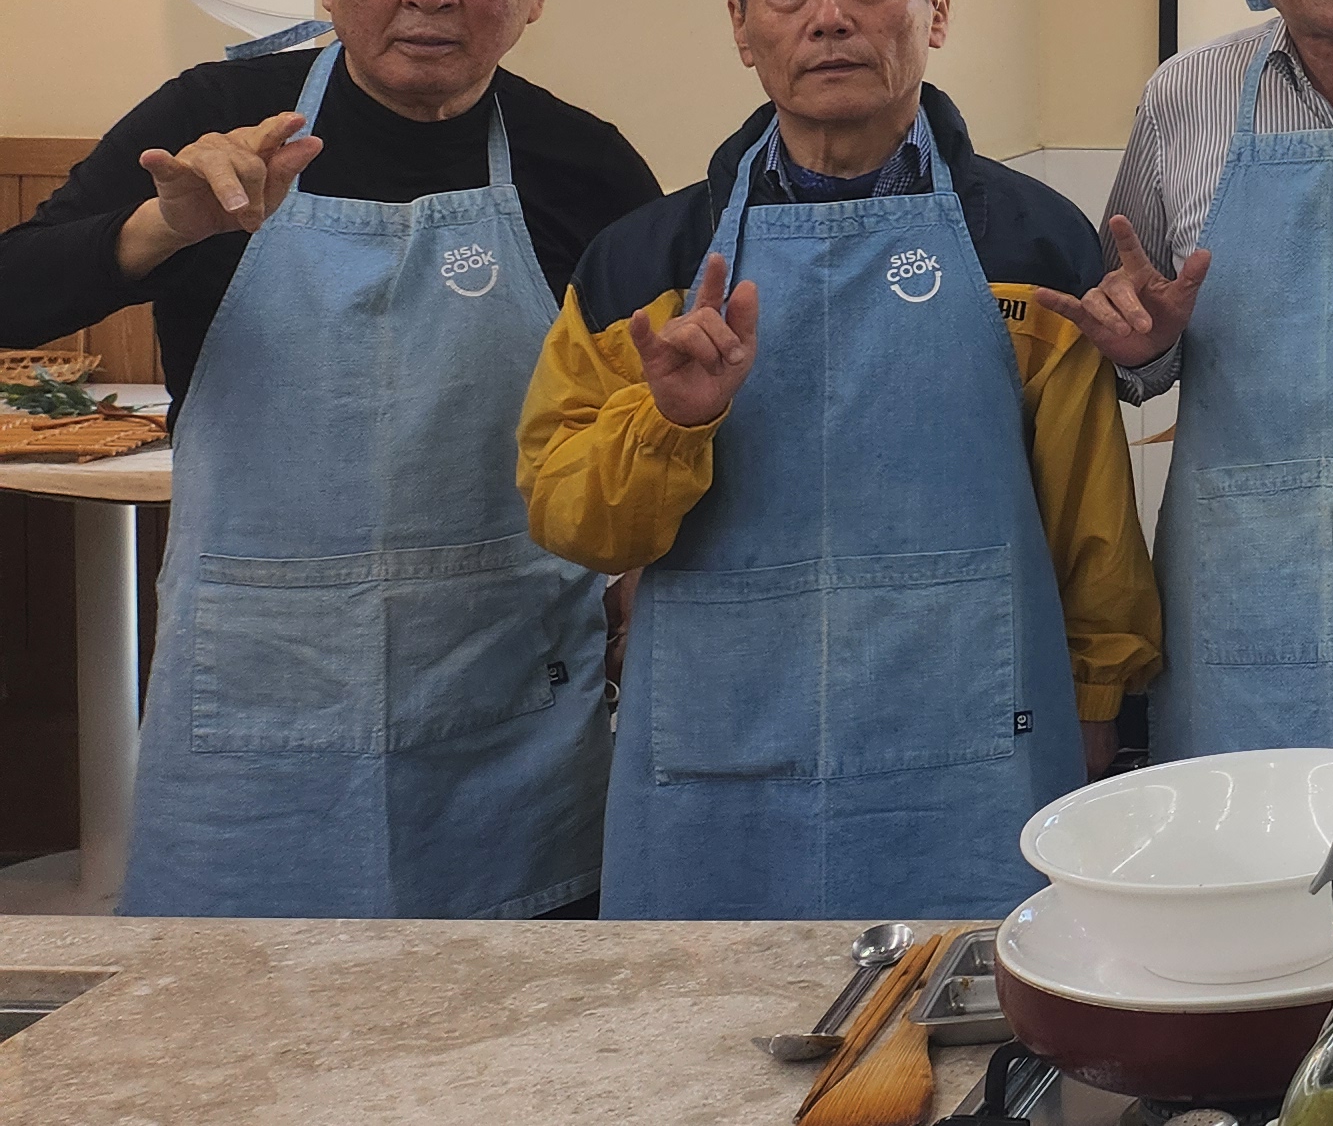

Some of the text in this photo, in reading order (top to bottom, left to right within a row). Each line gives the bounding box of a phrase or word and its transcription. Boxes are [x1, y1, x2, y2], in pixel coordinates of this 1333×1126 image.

[444, 243, 484, 262] SISA
[890, 249, 928, 267] SISA
[441, 250, 496, 277] COOK
[887, 256, 940, 282] COOK
[1016, 714, 1027, 729] re
